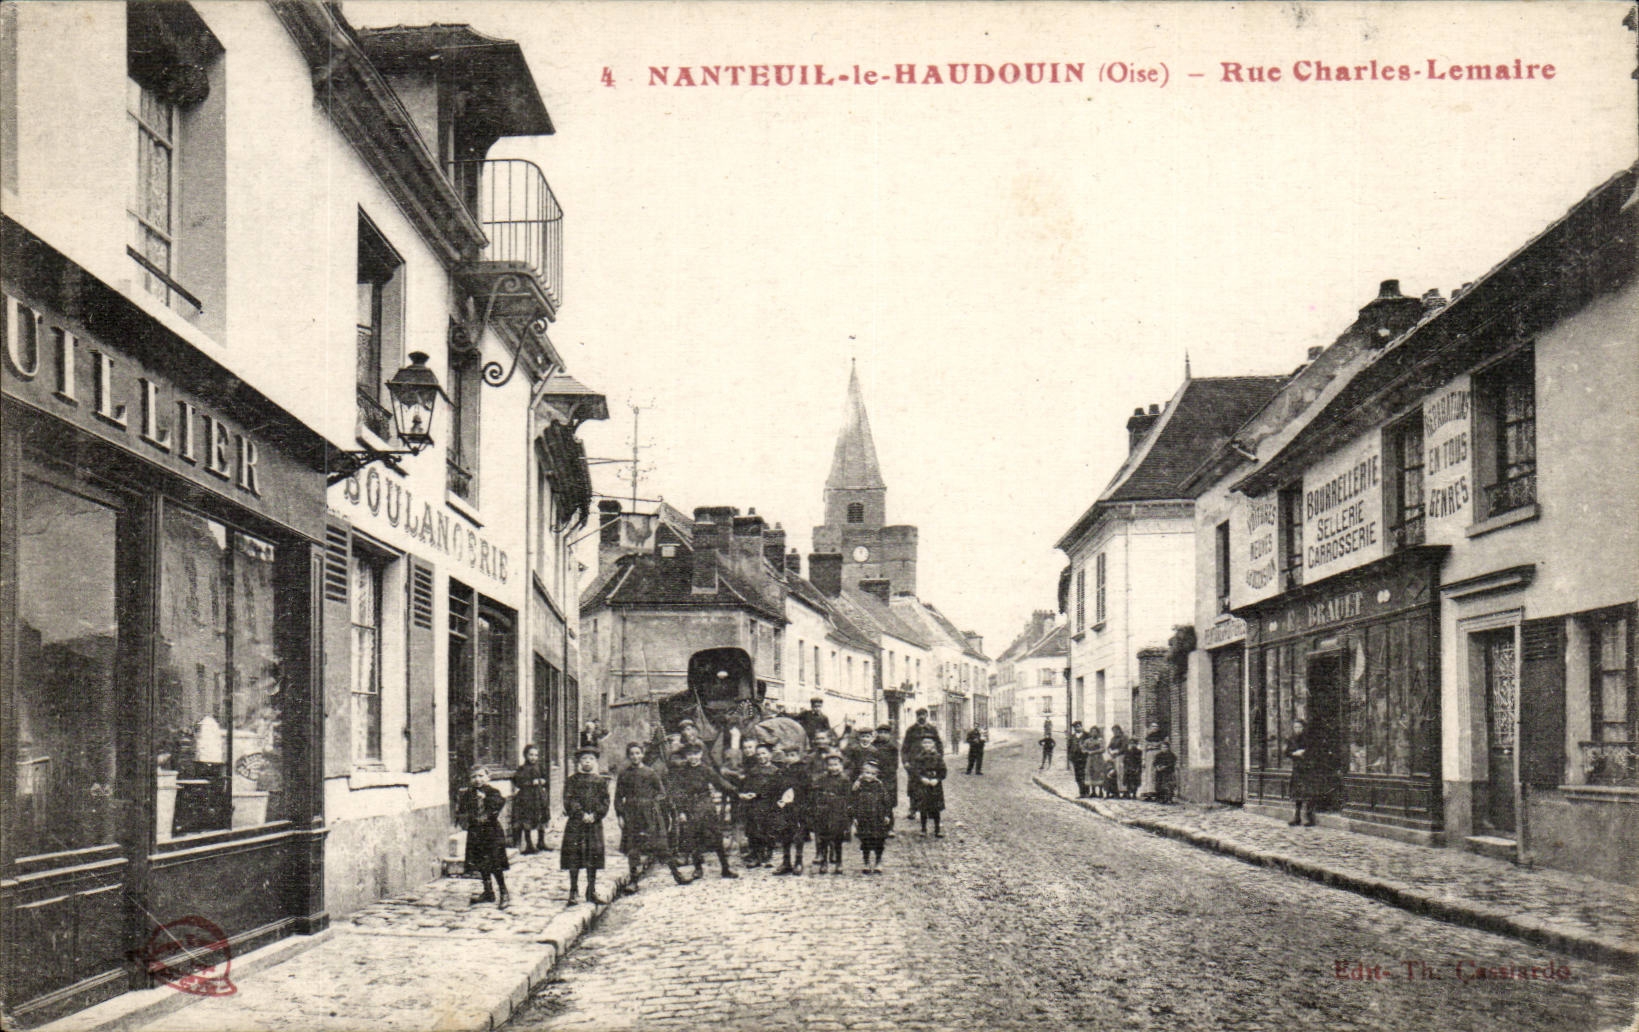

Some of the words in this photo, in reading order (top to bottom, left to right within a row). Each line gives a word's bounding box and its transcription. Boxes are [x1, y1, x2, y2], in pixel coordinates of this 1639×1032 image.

[1428, 444, 1441, 476] EN
[1443, 431, 1467, 470] TOUS
[1306, 454, 1379, 520] BOURRELLERIE
[1429, 475, 1469, 518] GENRES
[343, 465, 509, 585] BOULANGERIE
[1317, 499, 1365, 542] SELLERIE
[1308, 520, 1377, 569] CARROSSERIE
[1308, 590, 1364, 628] BRAULT
